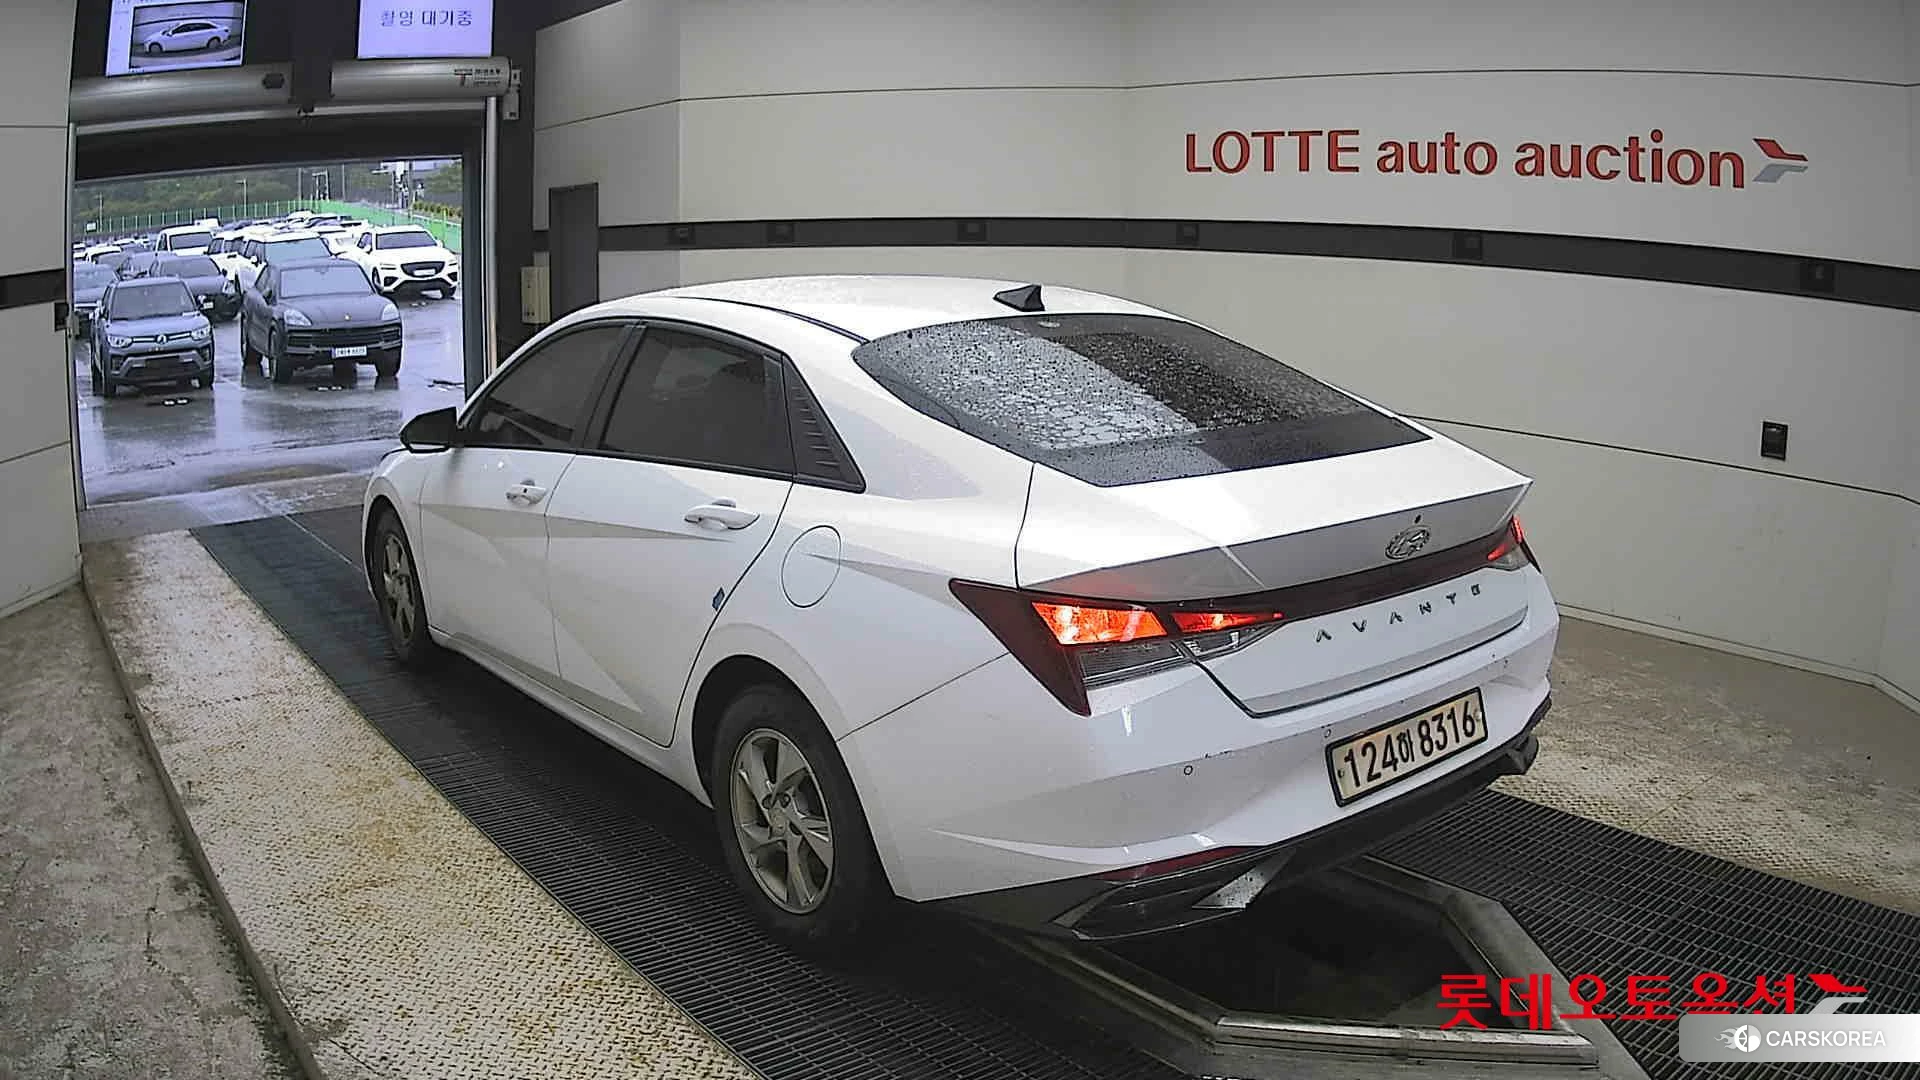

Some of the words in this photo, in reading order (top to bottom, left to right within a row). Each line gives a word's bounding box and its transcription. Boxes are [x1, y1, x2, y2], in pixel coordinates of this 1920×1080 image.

[421, 10, 472, 27] 대기중
[1186, 130, 1360, 174] LOTTE
[1376, 131, 1498, 175] auto
[1514, 128, 1745, 188] auction
